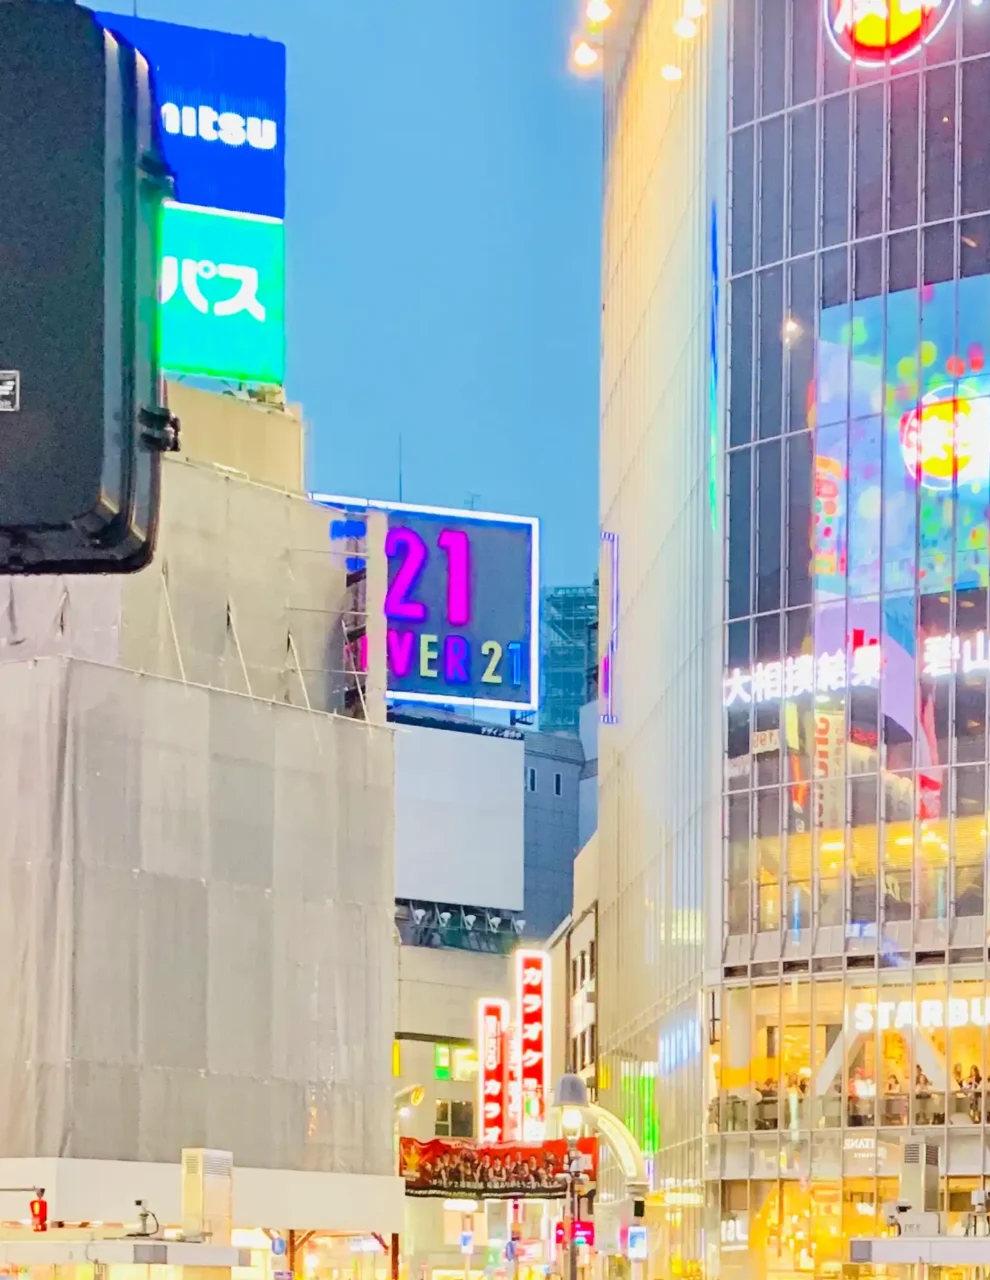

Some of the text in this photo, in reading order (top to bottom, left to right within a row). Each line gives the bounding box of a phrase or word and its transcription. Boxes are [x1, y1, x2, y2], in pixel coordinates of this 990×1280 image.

[385, 526, 469, 626] 21
[481, 640, 524, 686] 21
[522, 967, 543, 1067] カラオケ
